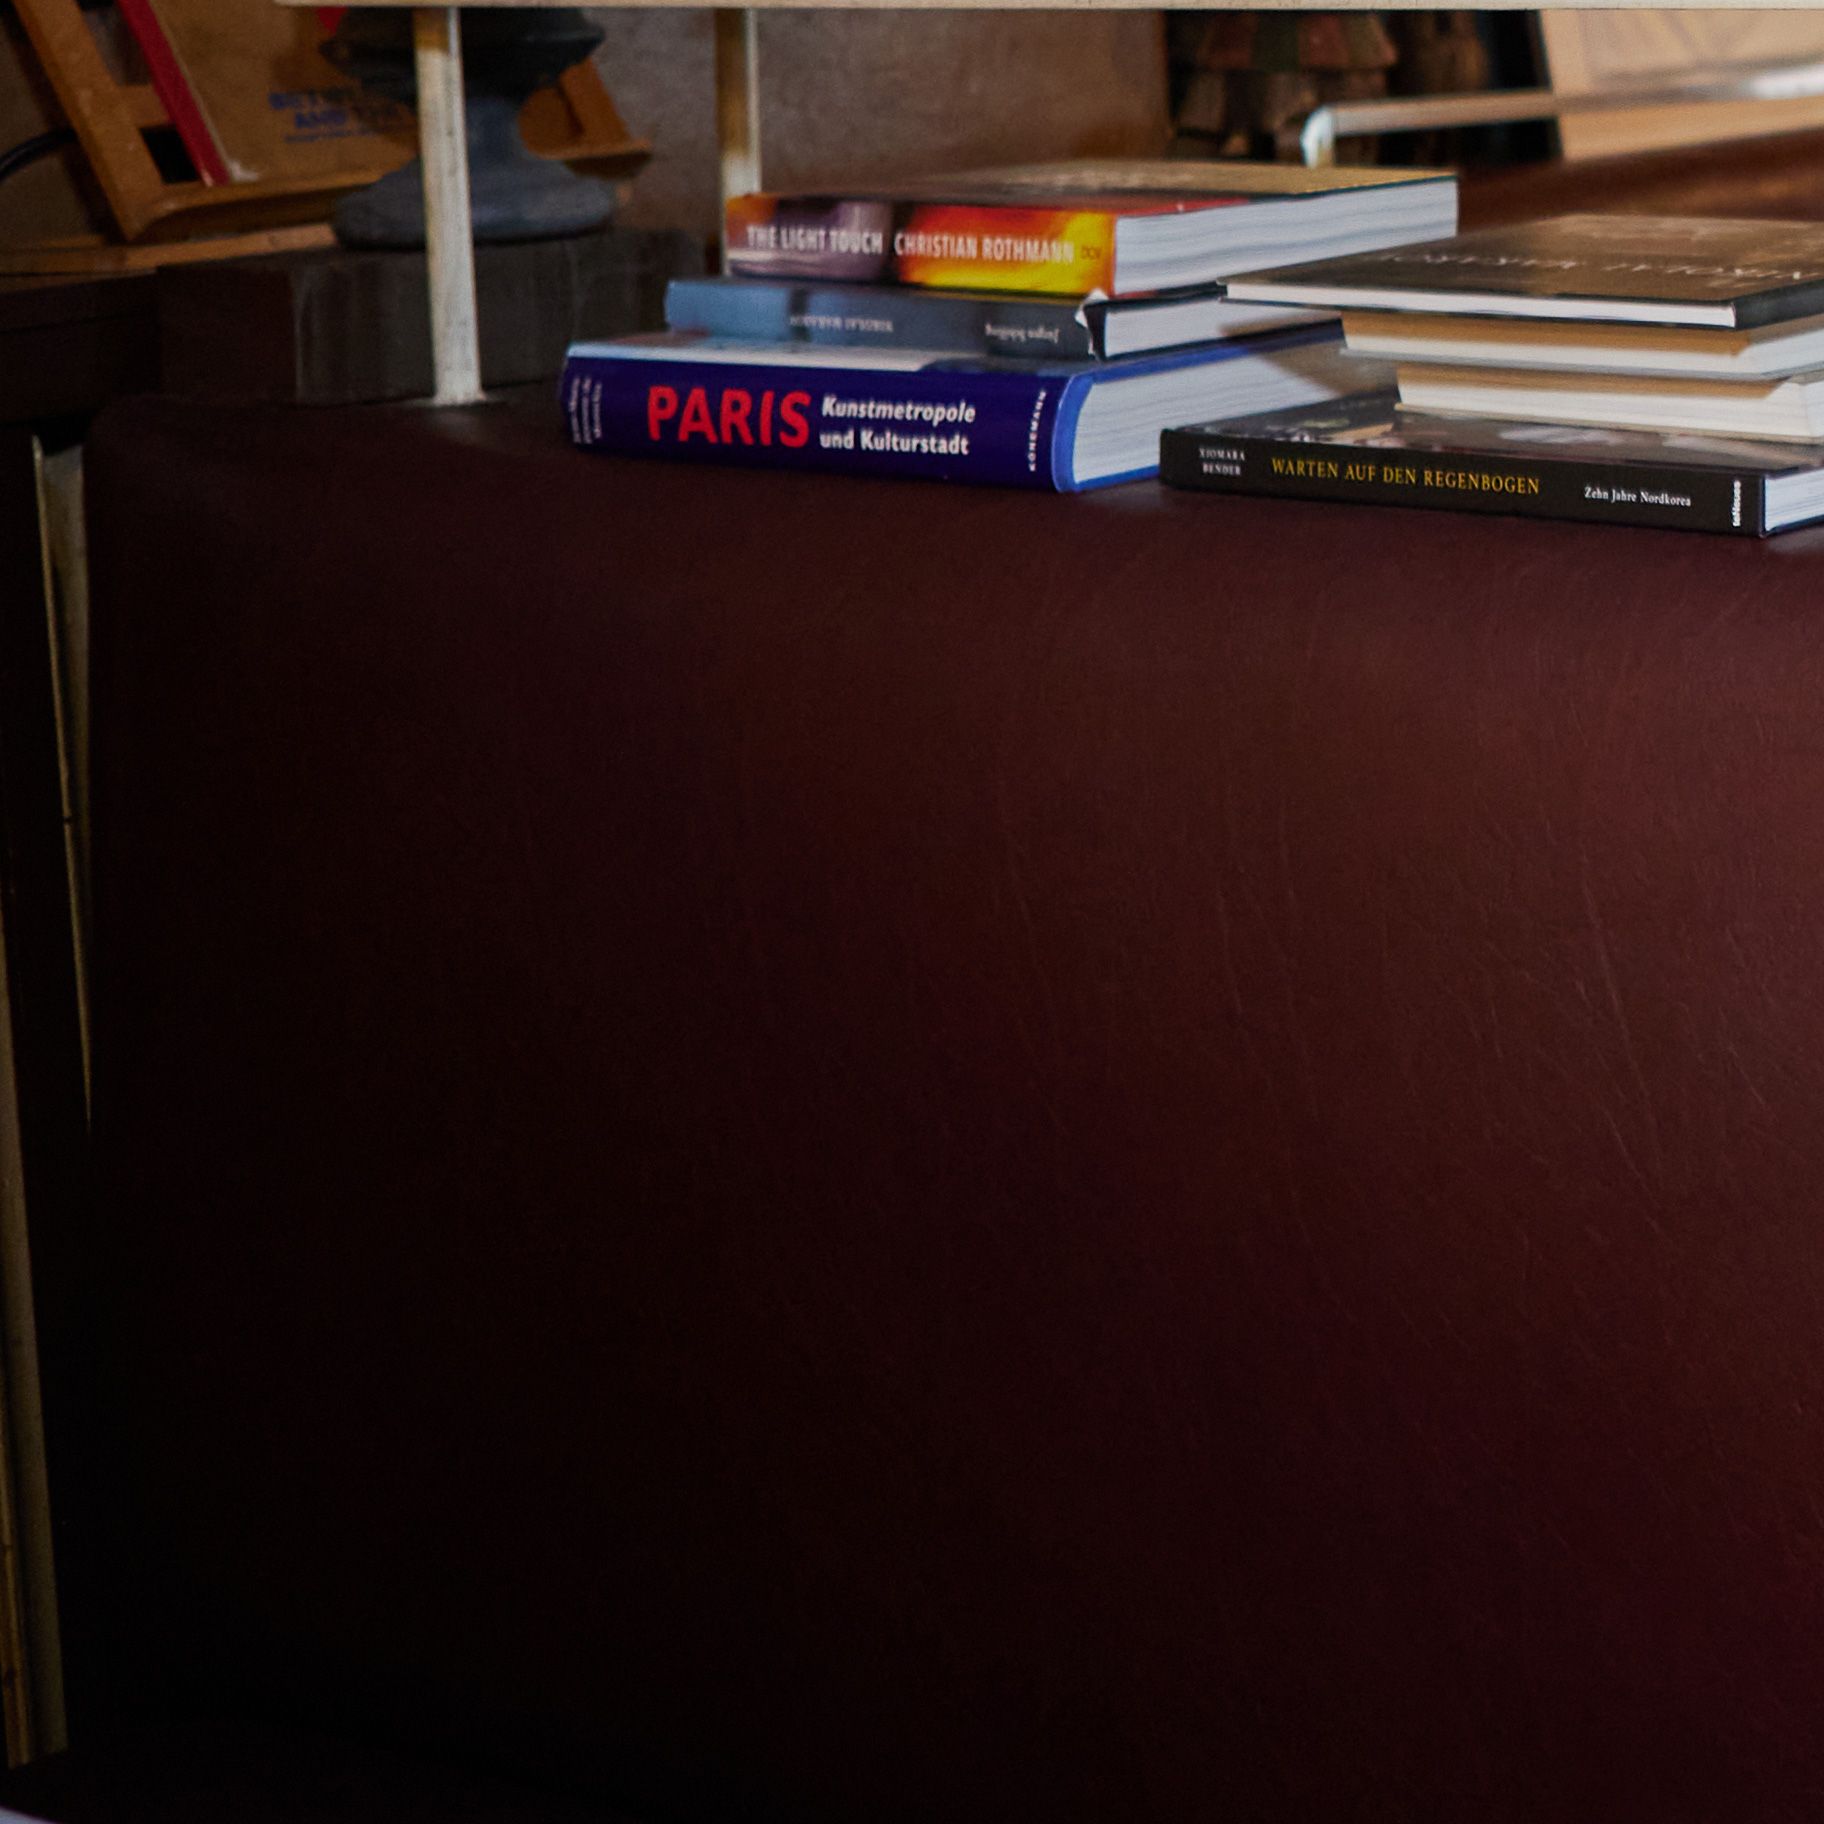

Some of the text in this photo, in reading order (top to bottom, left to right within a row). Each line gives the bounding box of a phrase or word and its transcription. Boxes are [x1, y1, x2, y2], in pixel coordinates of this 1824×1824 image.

[748, 225, 776, 249] THE
[780, 228, 826, 251] LIGHT
[829, 230, 883, 254] TOUCH
[894, 232, 977, 259] CHRISTIAN
[982, 237, 1074, 263] ROTHMANN
[647, 385, 811, 448] PARIS
[821, 393, 976, 426] Kunstmetropole
[819, 428, 969, 456] und Kulturstadt
[1200, 448, 1246, 461] XIOMARA
[1202, 463, 1242, 476] BENDER
[1271, 457, 1541, 495] WARTEN AUF DEN REGENBOGEN
[1584, 486, 1692, 507] Zehn Jahre Nordkorea
